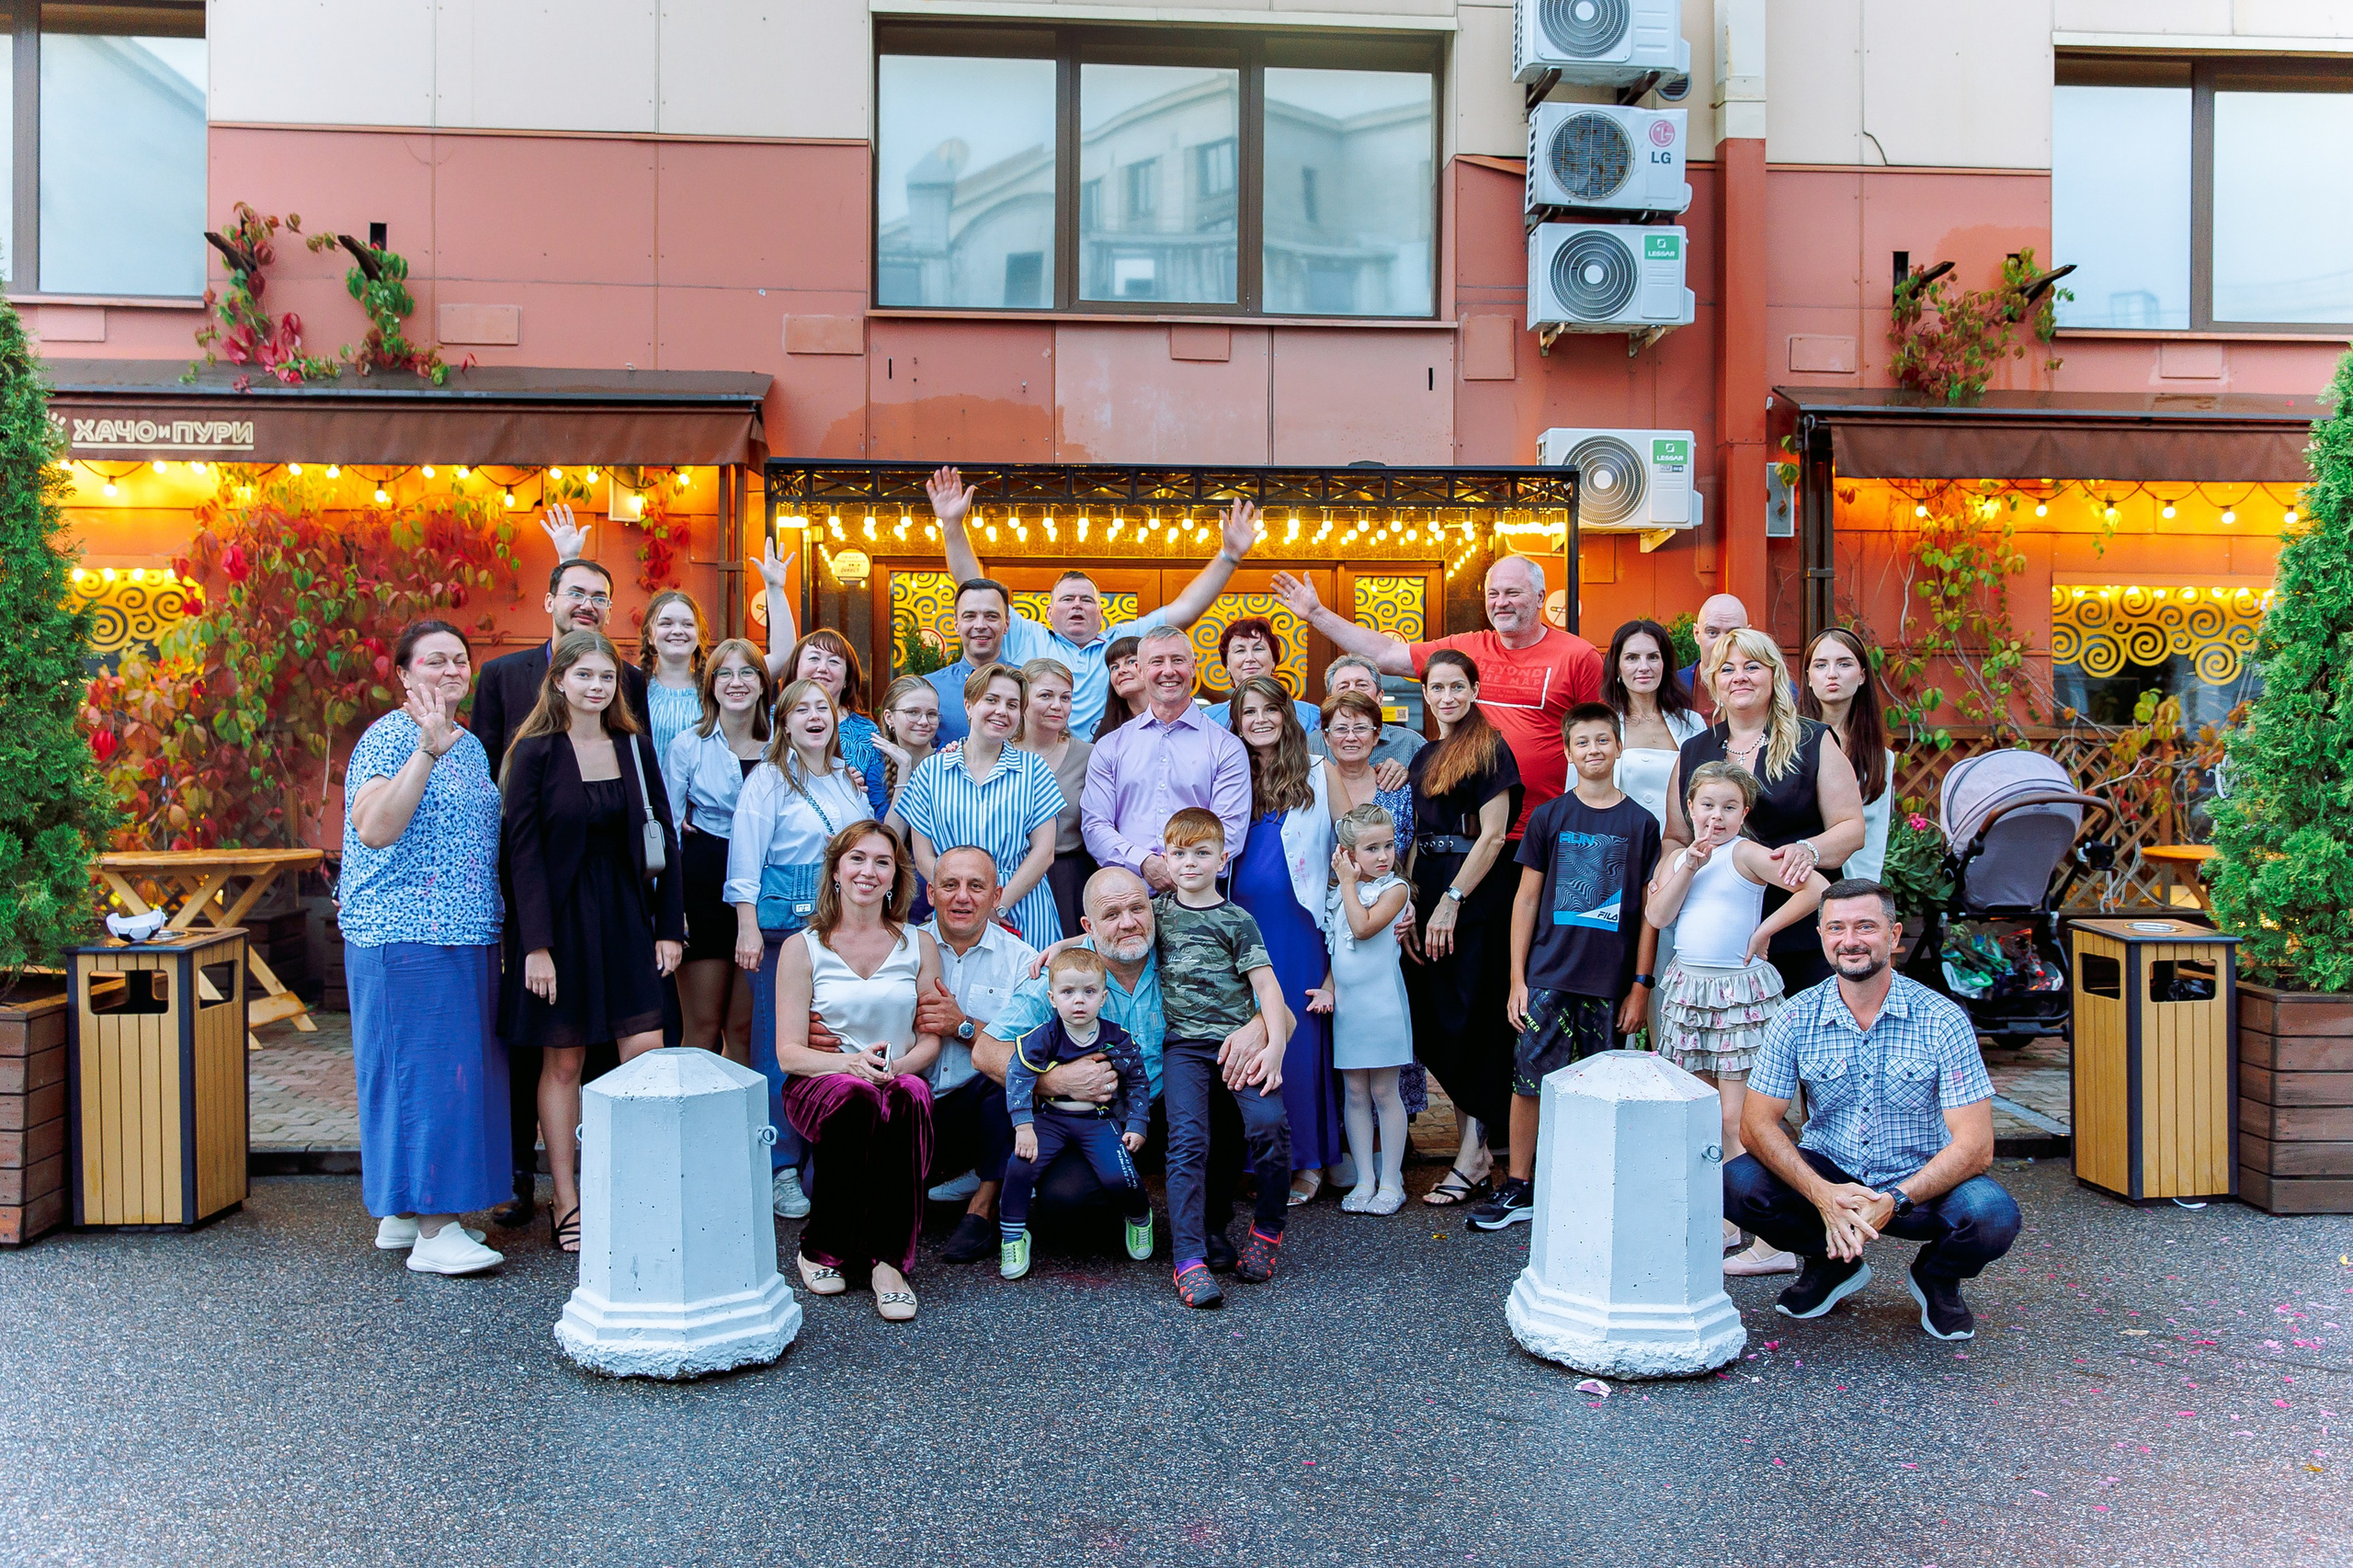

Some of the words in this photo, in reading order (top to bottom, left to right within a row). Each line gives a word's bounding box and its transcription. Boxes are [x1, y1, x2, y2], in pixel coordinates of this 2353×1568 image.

[1651, 151, 1671, 165] LG
[1478, 661, 1543, 677] BEYOND
[1482, 674, 1502, 684] HE
[1508, 676, 1541, 687] MAP
[1559, 832, 1596, 845] RUN
[1597, 911, 1619, 921] FILA
[1557, 1015, 1574, 1039] LEVEL
